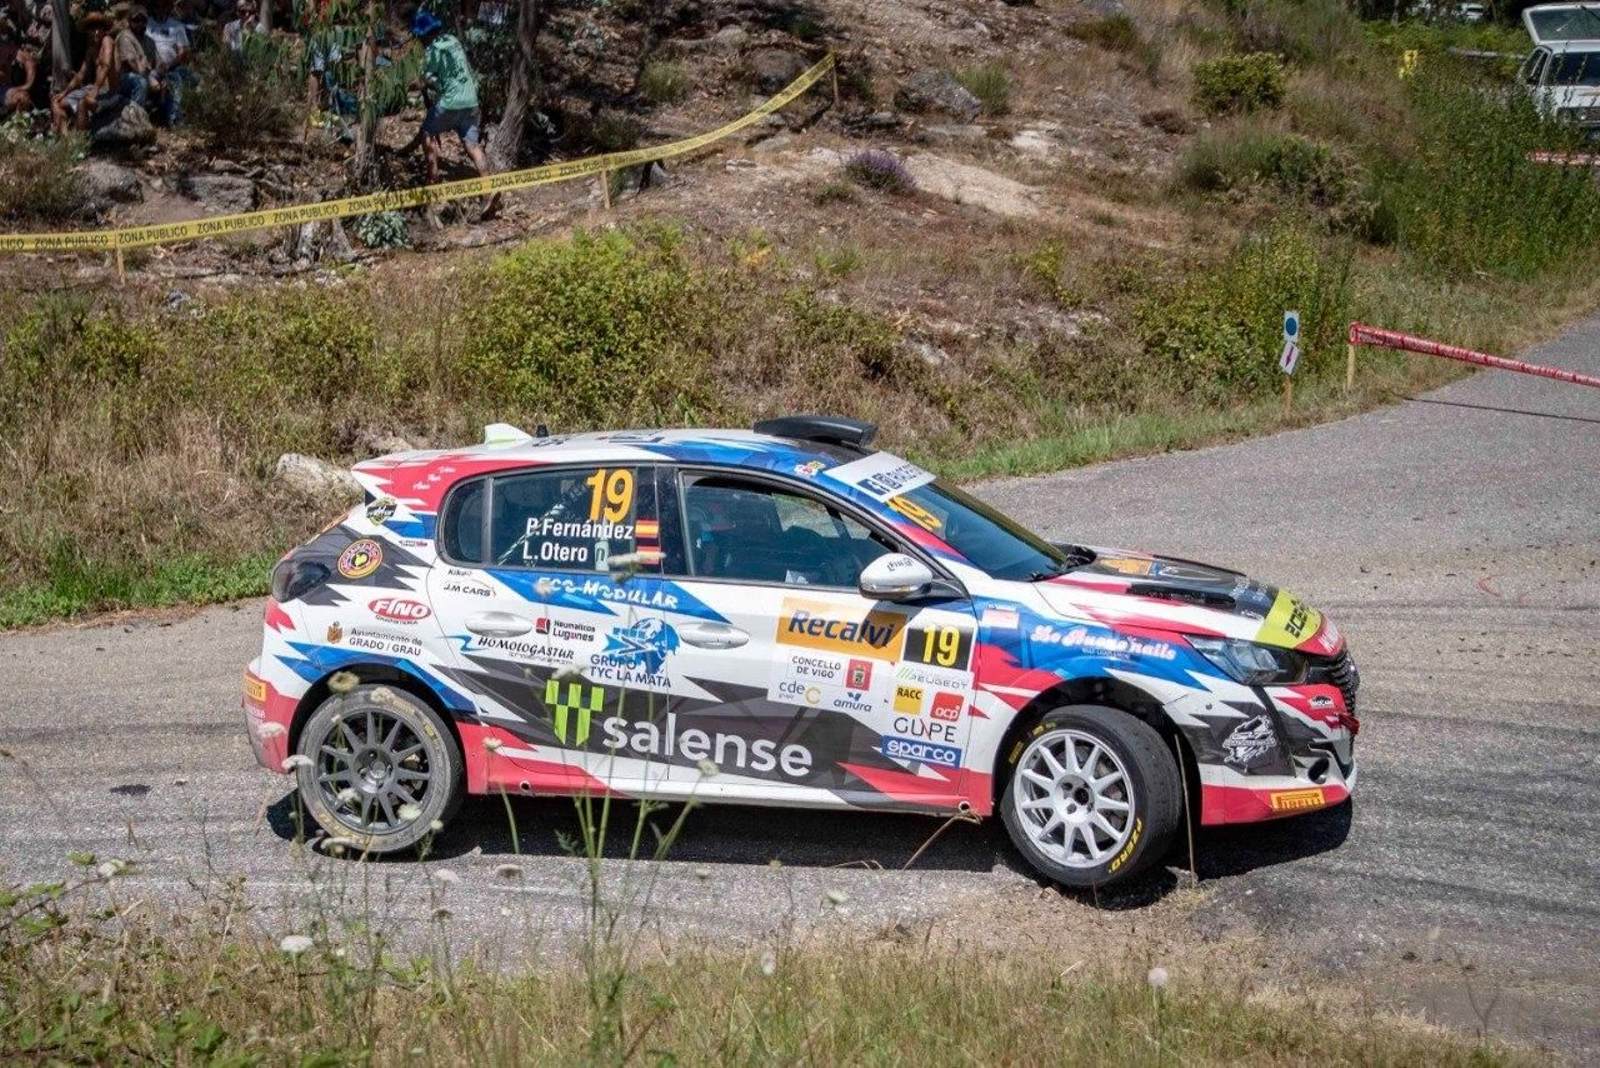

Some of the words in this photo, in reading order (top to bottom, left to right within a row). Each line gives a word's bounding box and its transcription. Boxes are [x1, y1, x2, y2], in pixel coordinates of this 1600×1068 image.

[490, 177, 515, 189] ZONA
[347, 200, 372, 212] ZONA
[273, 211, 299, 223] ZONA
[197, 221, 223, 234] ZONA
[118, 232, 145, 244] ZONA
[587, 468, 634, 522] 19
[462, 586, 491, 597] CARS
[373, 599, 429, 618] FINO
[788, 609, 895, 647] Recalvi
[349, 637, 385, 651] GRADO
[391, 643, 421, 656] GRAU
[922, 624, 961, 666] 19
[590, 654, 637, 670] GRUPO
[791, 655, 842, 670] CONCELLO
[590, 666, 613, 680] TYC
[616, 671, 633, 682] LA
[635, 673, 672, 688] MATA
[796, 666, 810, 675] DE
[811, 668, 835, 679] VIGO
[896, 687, 922, 700] RACC
[833, 699, 872, 712] amura
[602, 712, 813, 777] salense
[887, 740, 956, 762] sparco
